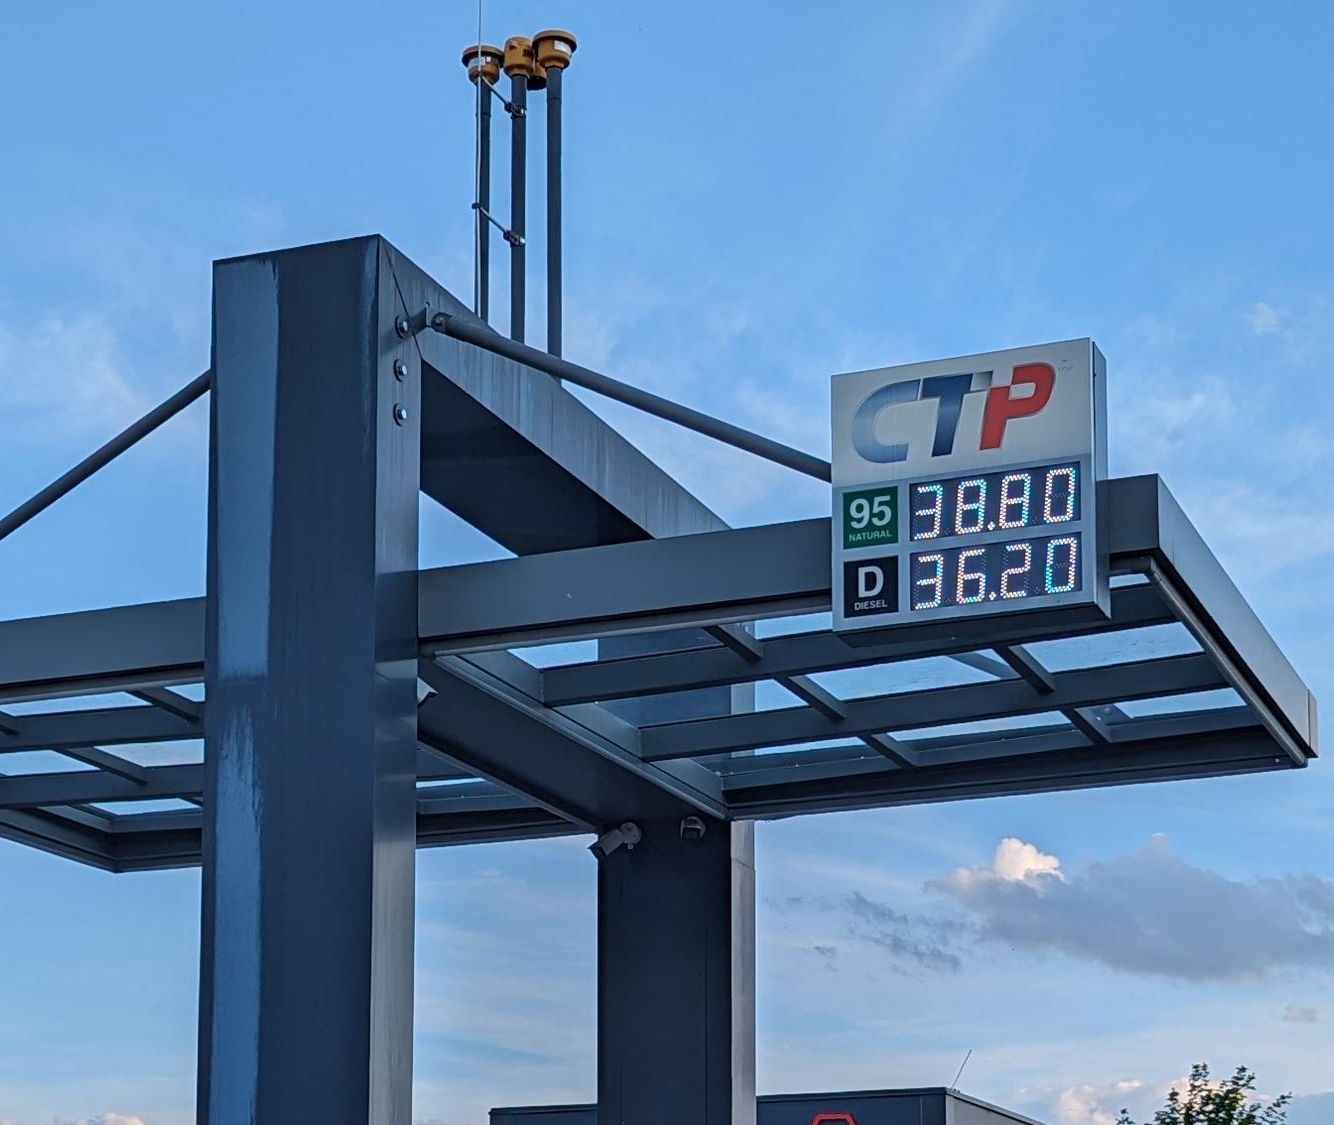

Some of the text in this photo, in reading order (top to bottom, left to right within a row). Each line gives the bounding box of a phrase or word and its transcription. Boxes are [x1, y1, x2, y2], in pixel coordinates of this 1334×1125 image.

[852, 362, 1056, 463] CTP
[849, 495, 892, 529] 95
[914, 467, 1076, 539] 38.80
[849, 529, 892, 541] NATURAL
[857, 565, 884, 598] D
[915, 537, 1077, 609] 36.20
[854, 599, 888, 611] DIESEL
